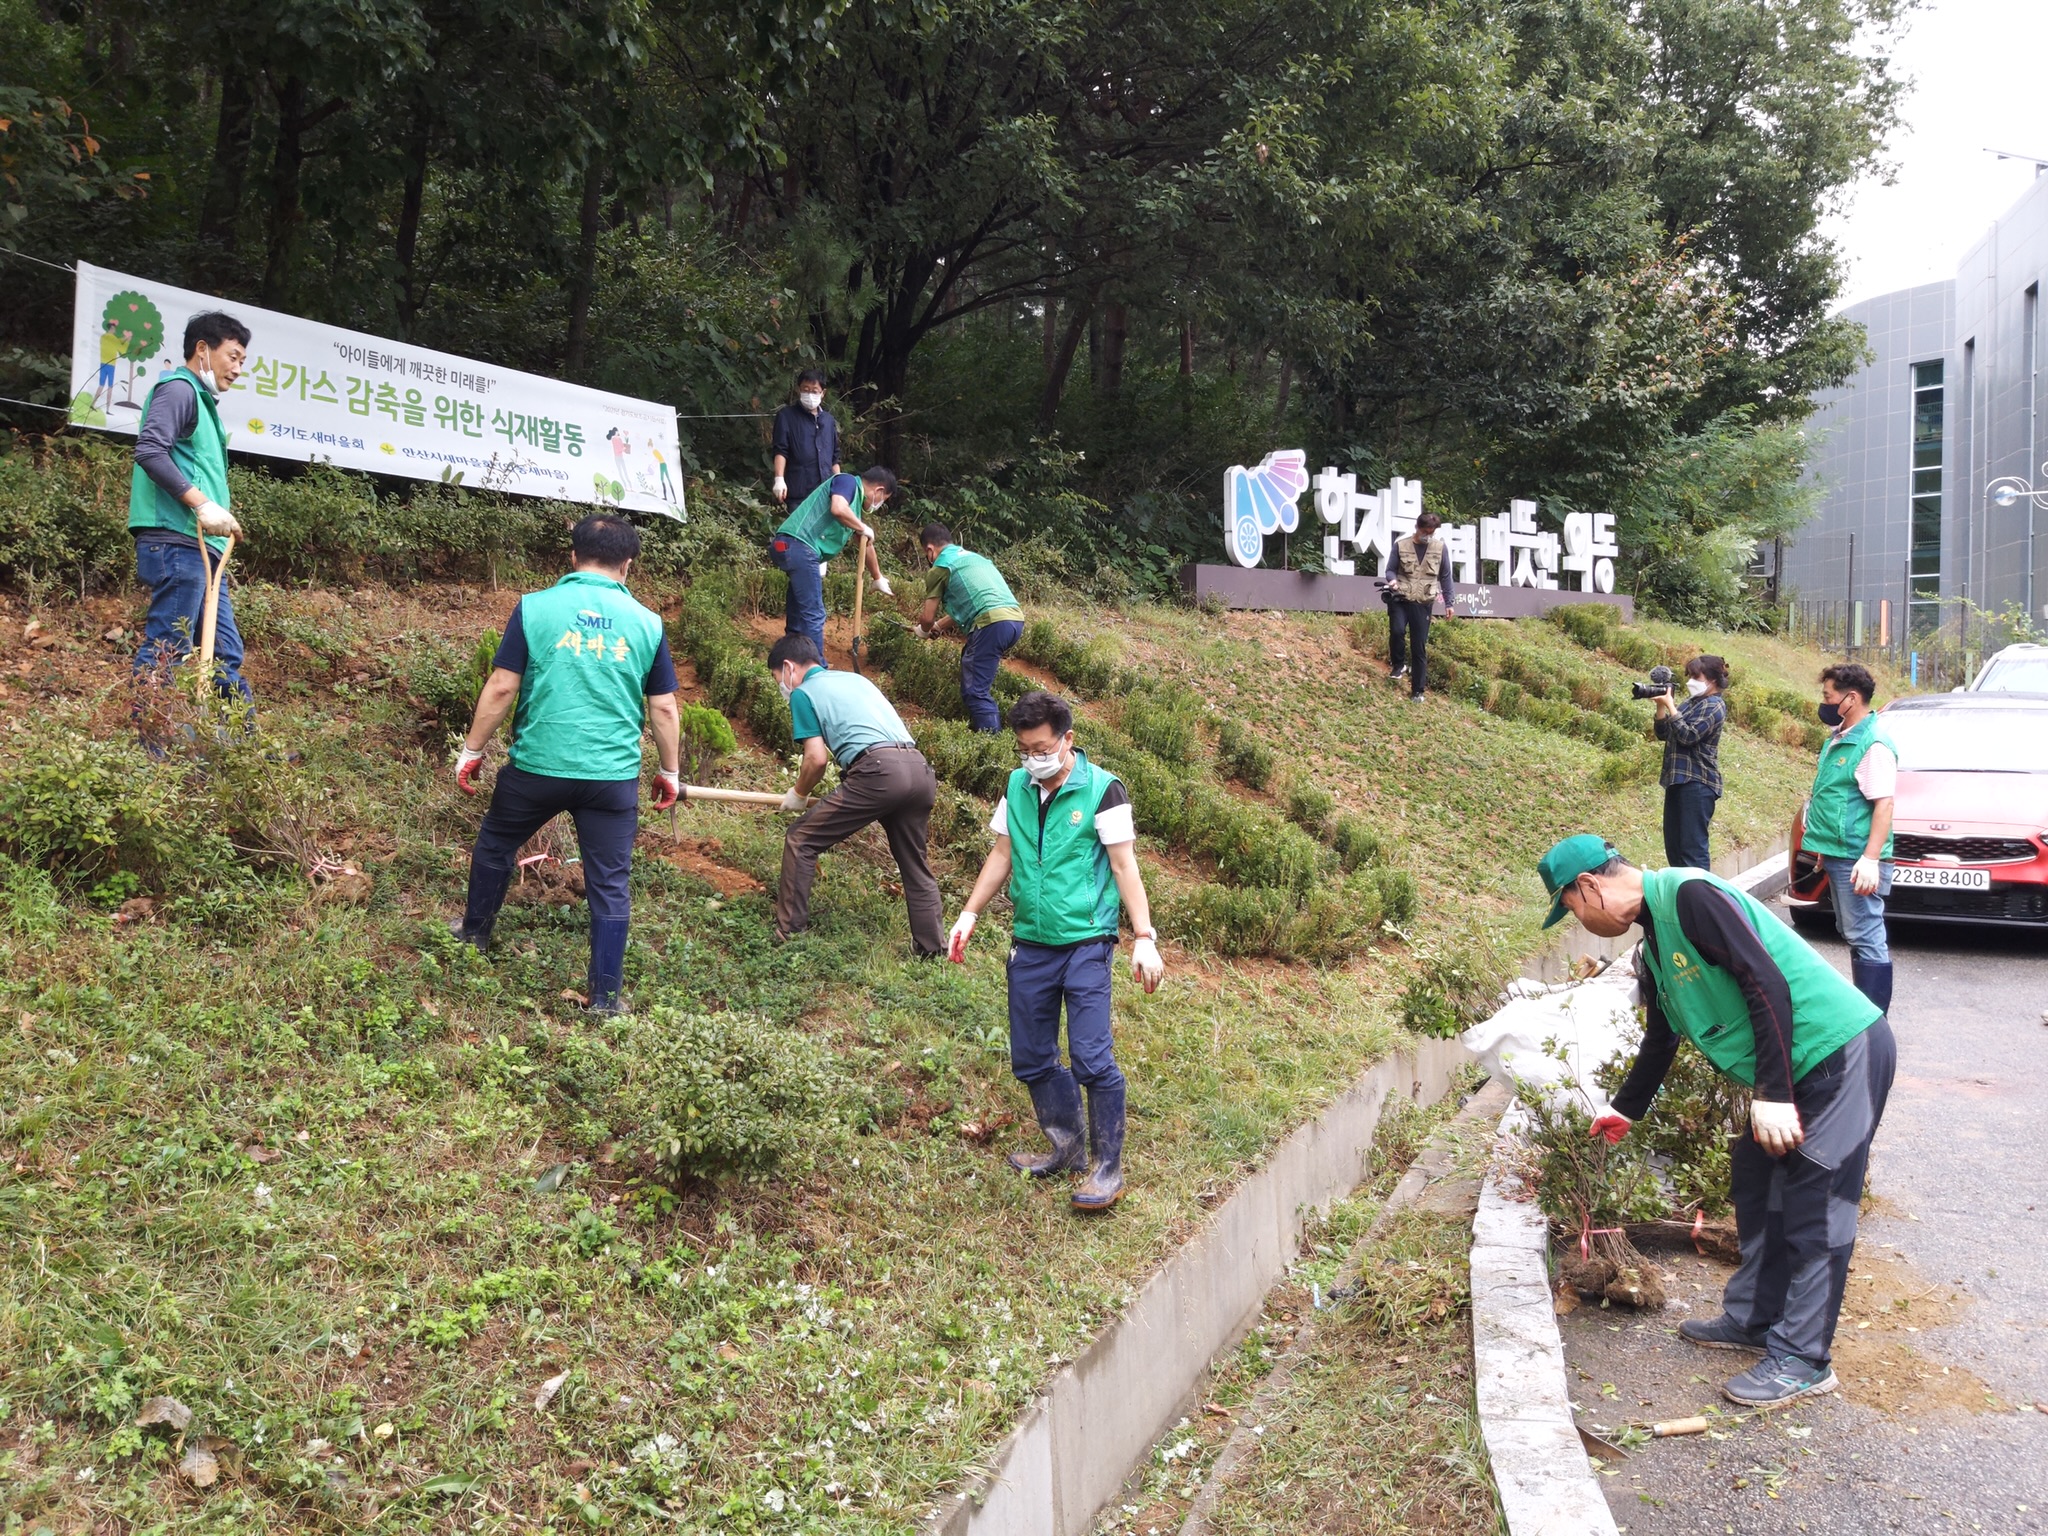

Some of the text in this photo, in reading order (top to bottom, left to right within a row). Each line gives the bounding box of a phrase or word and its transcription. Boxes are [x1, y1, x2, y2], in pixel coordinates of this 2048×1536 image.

[409, 361, 447, 384] 깨끗한
[346, 376, 427, 427] 감축을
[433, 395, 485, 438] 위한
[491, 408, 586, 457] 식재활동
[269, 423, 365, 450] 경기도새마을회
[1562, 511, 1619, 594] 와동
[576, 613, 613, 630] SMU
[555, 629, 631, 662] 새마을
[1892, 868, 1983, 887] 228보 8400
